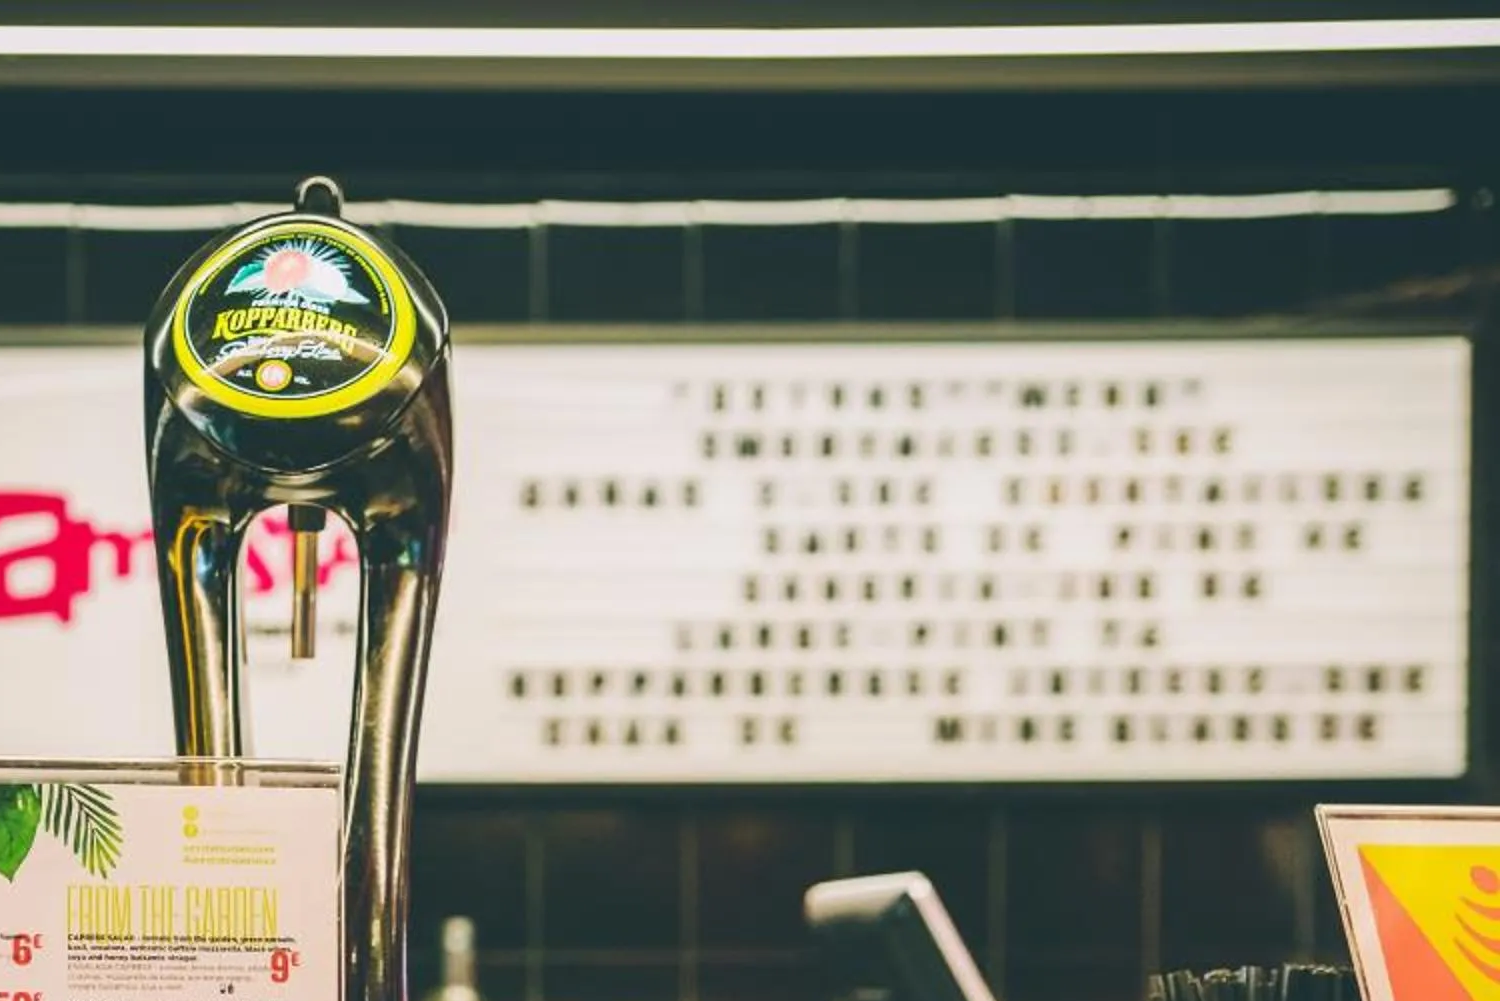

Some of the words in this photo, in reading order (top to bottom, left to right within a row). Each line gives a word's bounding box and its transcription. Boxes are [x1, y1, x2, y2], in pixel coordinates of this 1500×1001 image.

[67, 885, 132, 942] FROM
[185, 886, 278, 943] GARDEN
[13, 933, 43, 966] 6€
[271, 950, 301, 983] 9€
